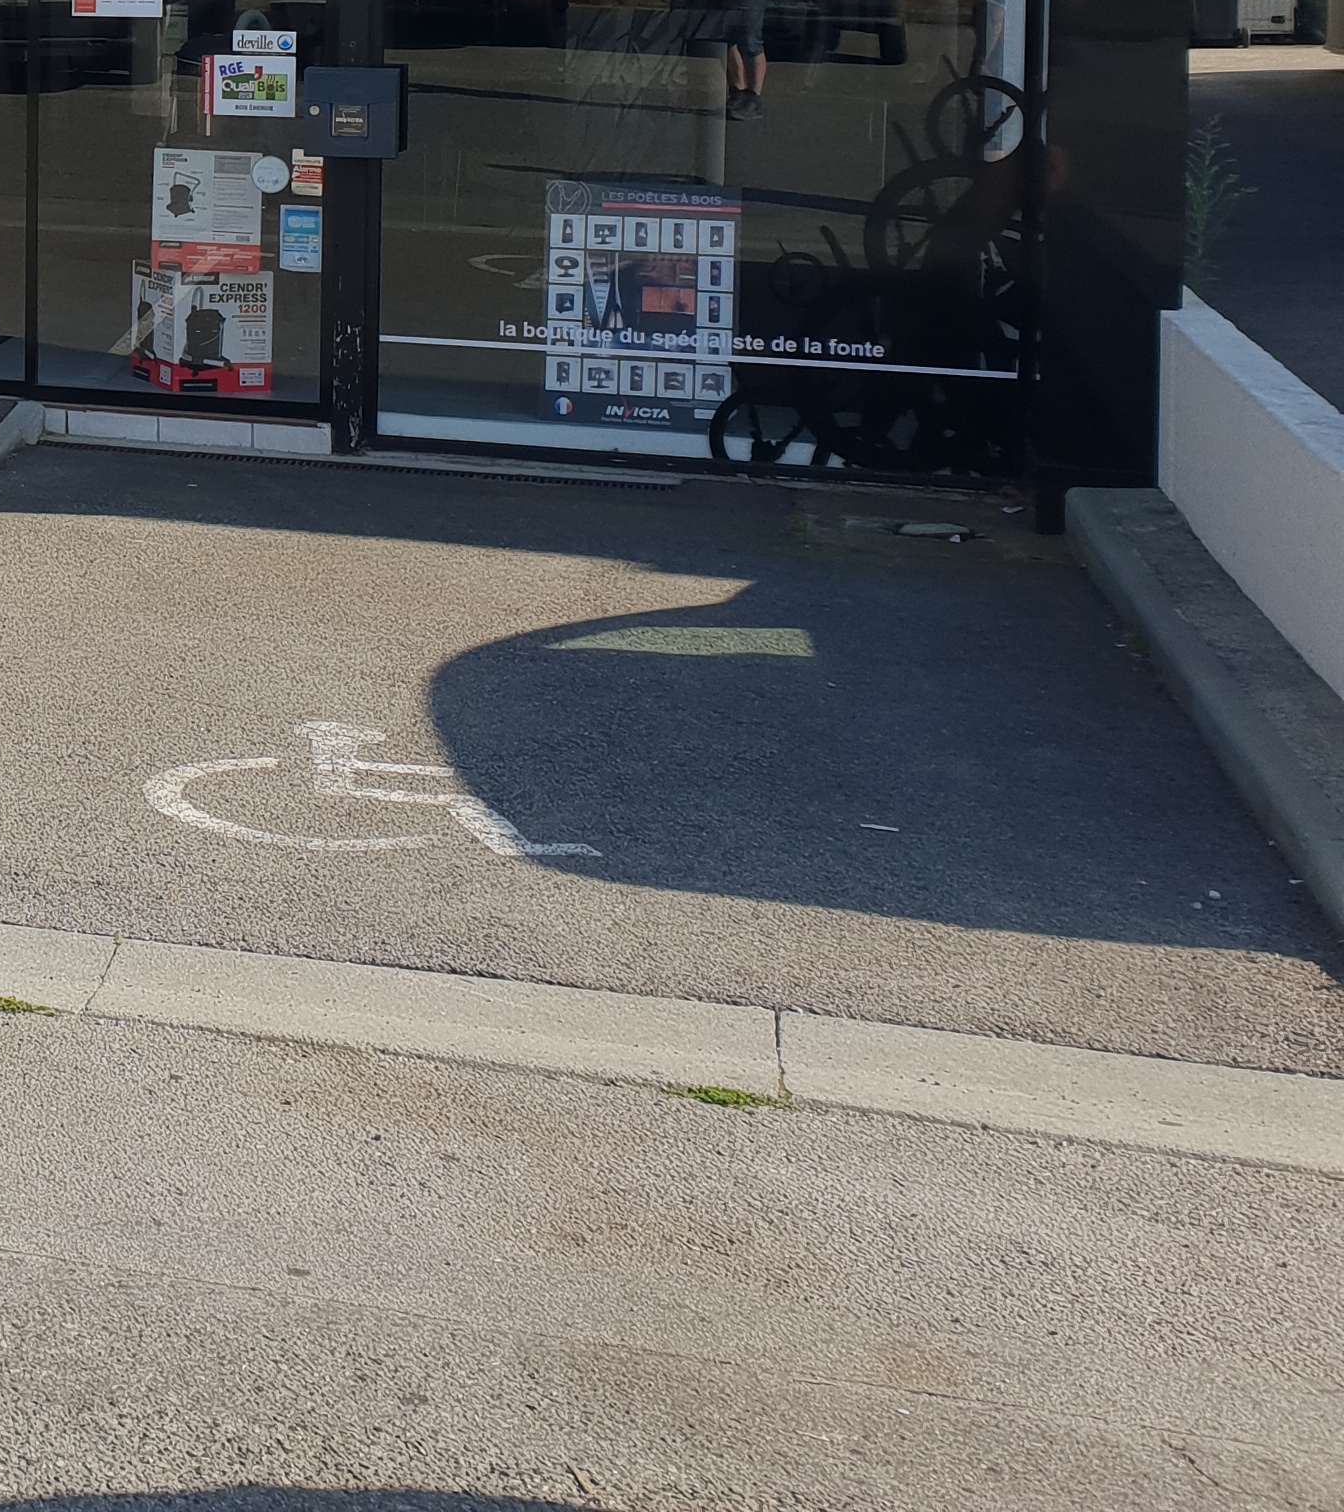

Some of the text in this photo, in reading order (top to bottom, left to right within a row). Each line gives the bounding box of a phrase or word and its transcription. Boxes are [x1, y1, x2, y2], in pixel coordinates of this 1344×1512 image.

[237, 34, 273, 49] deville
[218, 61, 245, 77] RGE
[601, 190, 722, 206] LES POÊLES À BOIS
[220, 283, 267, 293] CENDR'
[209, 293, 267, 303] EXPRESS
[238, 304, 267, 313] 1200
[499, 320, 885, 358] la boutique du spécialiste de la fonte
[605, 397, 670, 419] INVICTA
